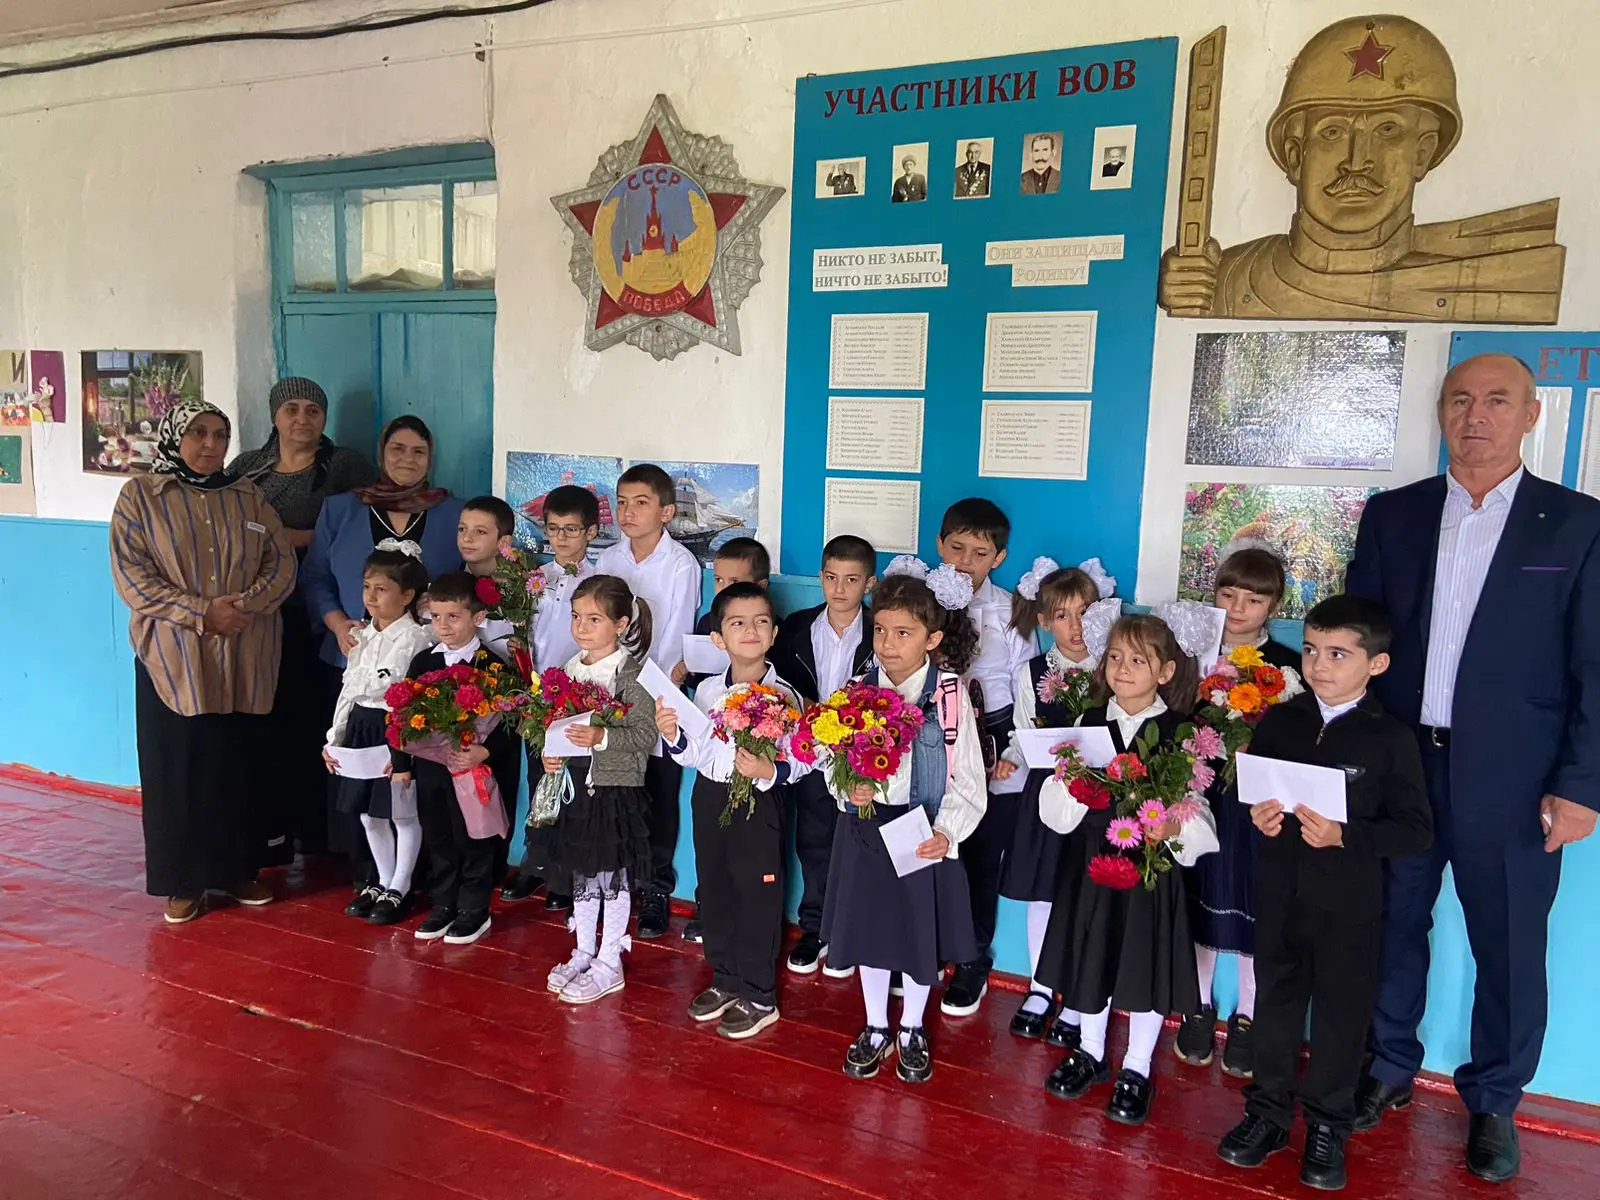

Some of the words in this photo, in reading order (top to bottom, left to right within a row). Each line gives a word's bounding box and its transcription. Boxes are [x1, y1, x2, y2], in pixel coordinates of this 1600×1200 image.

[824, 70, 1038, 117] УЧАСТНИКИ
[1057, 59, 1136, 96] ВОВ
[627, 168, 681, 190] СССР
[818, 255, 865, 267] НИКТО
[868, 254, 886, 265] НЕ
[889, 251, 940, 264] ЗАБЫТ,
[1025, 242, 1123, 259] ЗАЩИЩАЛИ
[815, 275, 860, 288] НИЧТО
[863, 274, 882, 286] НЕ
[885, 270, 947, 285] ЗАБЫТО!
